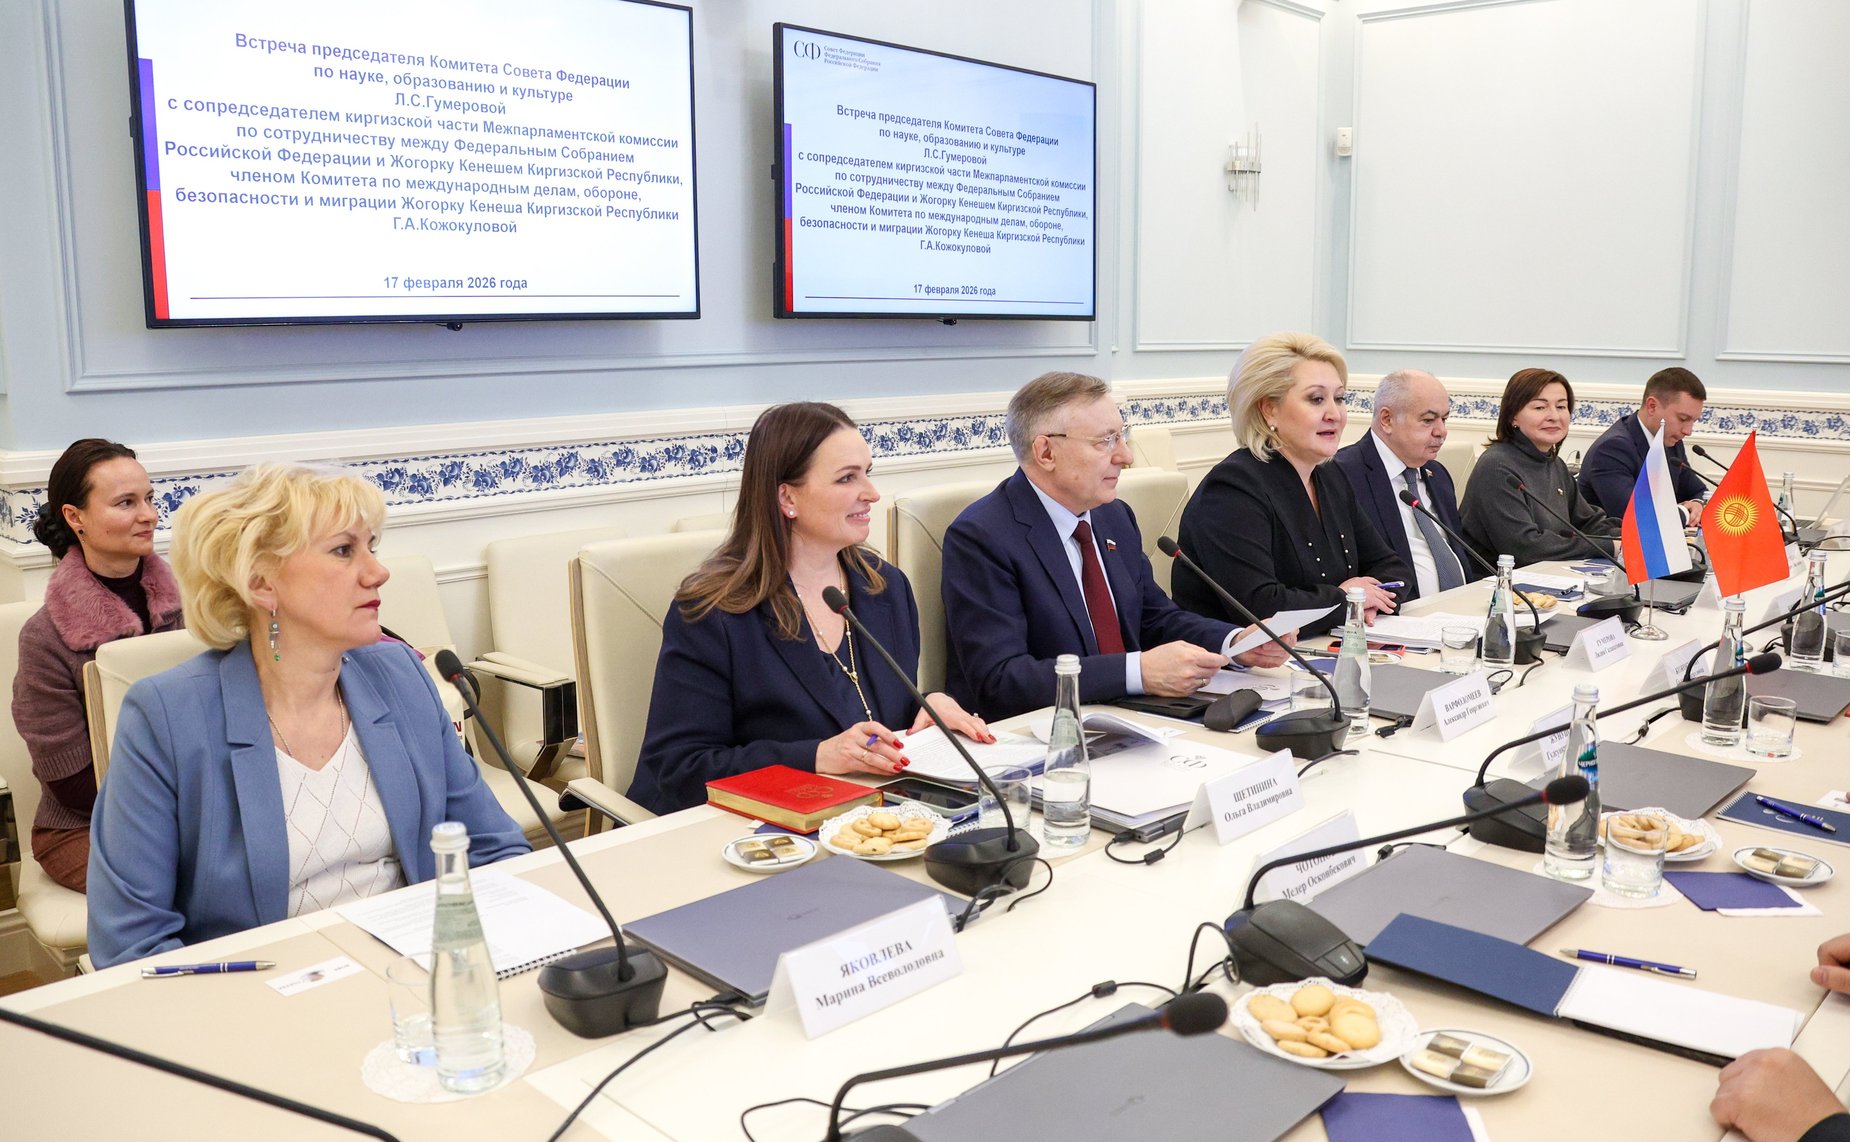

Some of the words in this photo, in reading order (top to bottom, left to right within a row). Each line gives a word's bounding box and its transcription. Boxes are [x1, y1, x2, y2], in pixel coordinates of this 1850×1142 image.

[235, 32, 307, 55] Встреча
[312, 44, 425, 67] председателя
[430, 54, 498, 74] Комитета
[503, 63, 552, 81] Совета
[556, 69, 630, 90] Федерации
[793, 40, 821, 60] СФ
[314, 66, 334, 78] по
[339, 69, 388, 86] науке,
[393, 72, 495, 94] образованию
[499, 85, 508, 95] и
[512, 86, 573, 104] культуре
[394, 92, 506, 115] Л.С.Гумеровой
[167, 98, 178, 110] с
[183, 99, 340, 122] сопредседателем
[345, 112, 432, 129] киргизской
[437, 119, 479, 132] части
[483, 120, 615, 143] Межпарламентской
[619, 135, 678, 149] комиссии
[837, 104, 876, 120] Встреча
[879, 113, 942, 129] председателя
[944, 120, 983, 135] Комитета
[985, 126, 1014, 139] Совета
[1015, 131, 1059, 146] Федерации
[236, 126, 258, 138] по
[263, 127, 396, 150] сотрудничеству
[401, 137, 449, 154] между
[454, 138, 557, 158] Федеральным
[561, 146, 635, 163] Собранием
[879, 129, 891, 138] по
[893, 131, 921, 143] науке,
[923, 133, 981, 150] образованию
[990, 144, 1026, 157] культуре
[924, 148, 987, 165] Л.С.Гумеровой
[164, 140, 272, 161] Российской
[277, 148, 371, 168] Федерации
[376, 156, 385, 167] и
[389, 154, 455, 174] Жогорку
[459, 158, 523, 175] Кенешем
[527, 163, 603, 180] Киргизской
[607, 168, 683, 187] Республики,
[798, 151, 804, 160] с
[807, 152, 893, 169] сопредседателем
[896, 163, 945, 175] киргизской
[947, 168, 971, 178] части
[973, 169, 1049, 187] Межпарламентской
[1051, 180, 1086, 191] комиссии
[230, 170, 295, 184] членом
[301, 170, 377, 188] Комитета
[382, 178, 401, 189] по
[406, 179, 530, 196] международным
[533, 185, 580, 199] делам,
[583, 186, 642, 203] обороне,
[795, 182, 854, 198] Российской
[857, 188, 909, 203] Федерации
[912, 195, 917, 203] и
[920, 194, 957, 209] Жогорку
[959, 197, 995, 210] Кенешем
[997, 201, 1041, 214] Киргизской
[1043, 205, 1088, 219] Республики,
[835, 172, 847, 181] по
[849, 173, 924, 191] сотрудничеству
[926, 181, 954, 194] между
[956, 182, 1015, 197] Федеральным
[1017, 188, 1060, 202] Собранием
[175, 187, 299, 206] безопасности
[304, 195, 314, 206] и
[319, 196, 396, 211] миграции
[401, 196, 465, 215] Жогорку
[469, 199, 523, 214] Кенеша
[527, 201, 602, 218] Киргизской
[606, 205, 679, 222] Республики
[830, 204, 867, 215] членом
[869, 205, 912, 218] Комитета
[915, 211, 926, 219] по
[928, 212, 999, 225] международным
[1000, 218, 1027, 228] делам,
[1029, 218, 1063, 231] обороне,
[393, 216, 517, 235] Г.А.Кожокуловой
[800, 216, 868, 231] безопасности
[871, 223, 876, 231] и
[879, 224, 923, 235] миграции
[925, 225, 962, 239] Жогорку
[964, 228, 994, 239] Кенеша
[996, 230, 1040, 243] Киргизской
[1042, 233, 1085, 246] Республики
[920, 240, 991, 255] Г.А.Кожокуловой
[384, 276, 399, 289] 17
[403, 276, 464, 292] февраля
[467, 276, 497, 289] 2026
[500, 279, 528, 291] года
[914, 284, 923, 293] 17
[924, 284, 959, 296] февраля
[961, 285, 978, 295] 2026
[979, 288, 996, 296] года
[1224, 808, 1247, 822] Ольга
[1246, 788, 1293, 813] Владимировна
[1233, 777, 1278, 803] ЩЕТИНИНА
[840, 940, 913, 978] ЯКОВЛЕВА
[816, 982, 866, 1010] Марина
[867, 949, 945, 988] Всеволодовна
